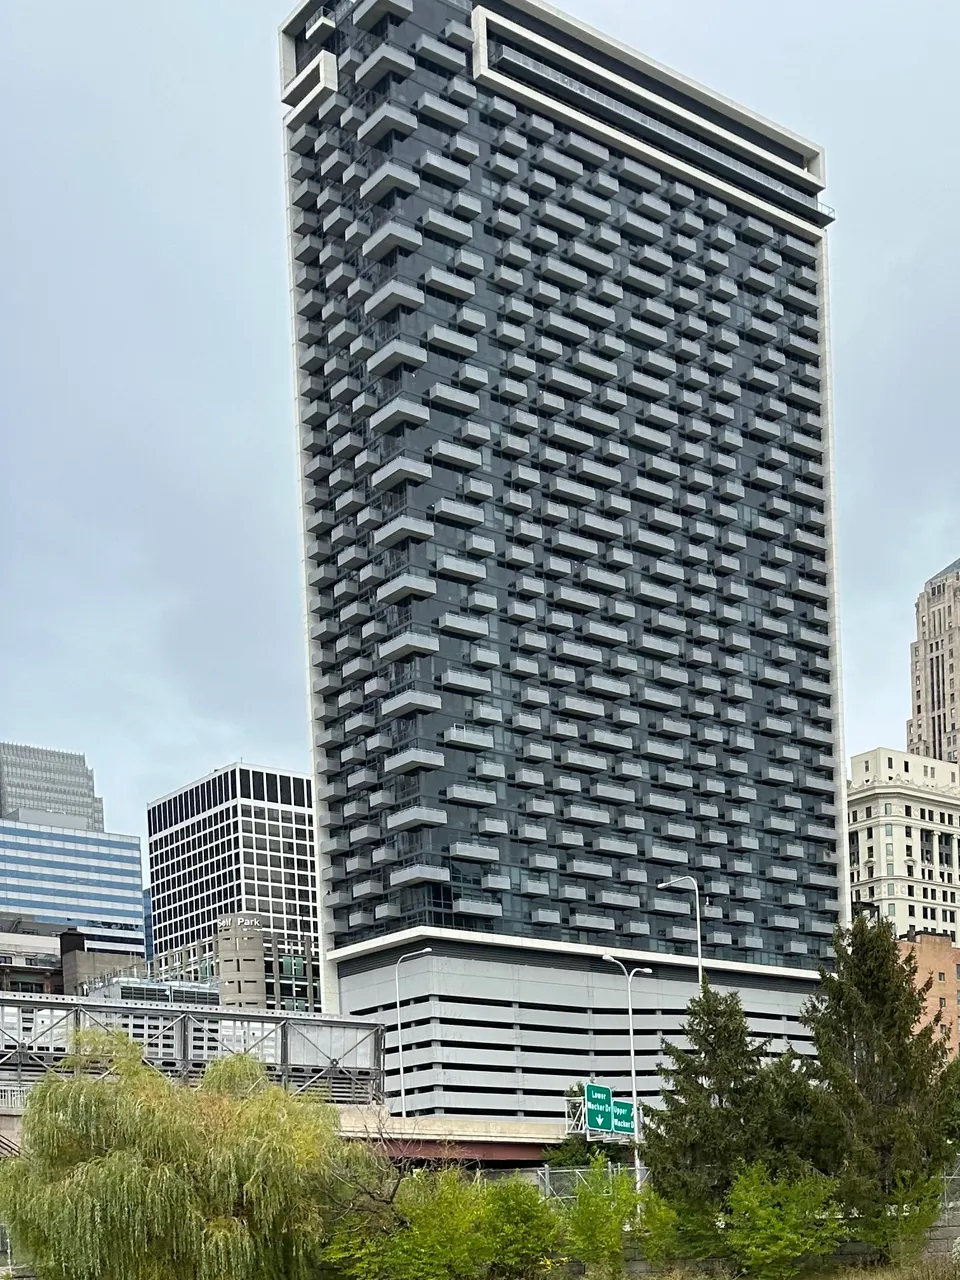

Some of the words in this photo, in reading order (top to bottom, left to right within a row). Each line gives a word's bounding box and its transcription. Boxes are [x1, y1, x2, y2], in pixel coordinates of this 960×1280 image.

[217, 918, 232, 928] Self
[237, 917, 260, 926] Park
[591, 1090, 606, 1100] Lower
[587, 1101, 605, 1112] Wacker
[613, 1106, 627, 1116] Upper
[614, 1118, 631, 1128] Wacker
